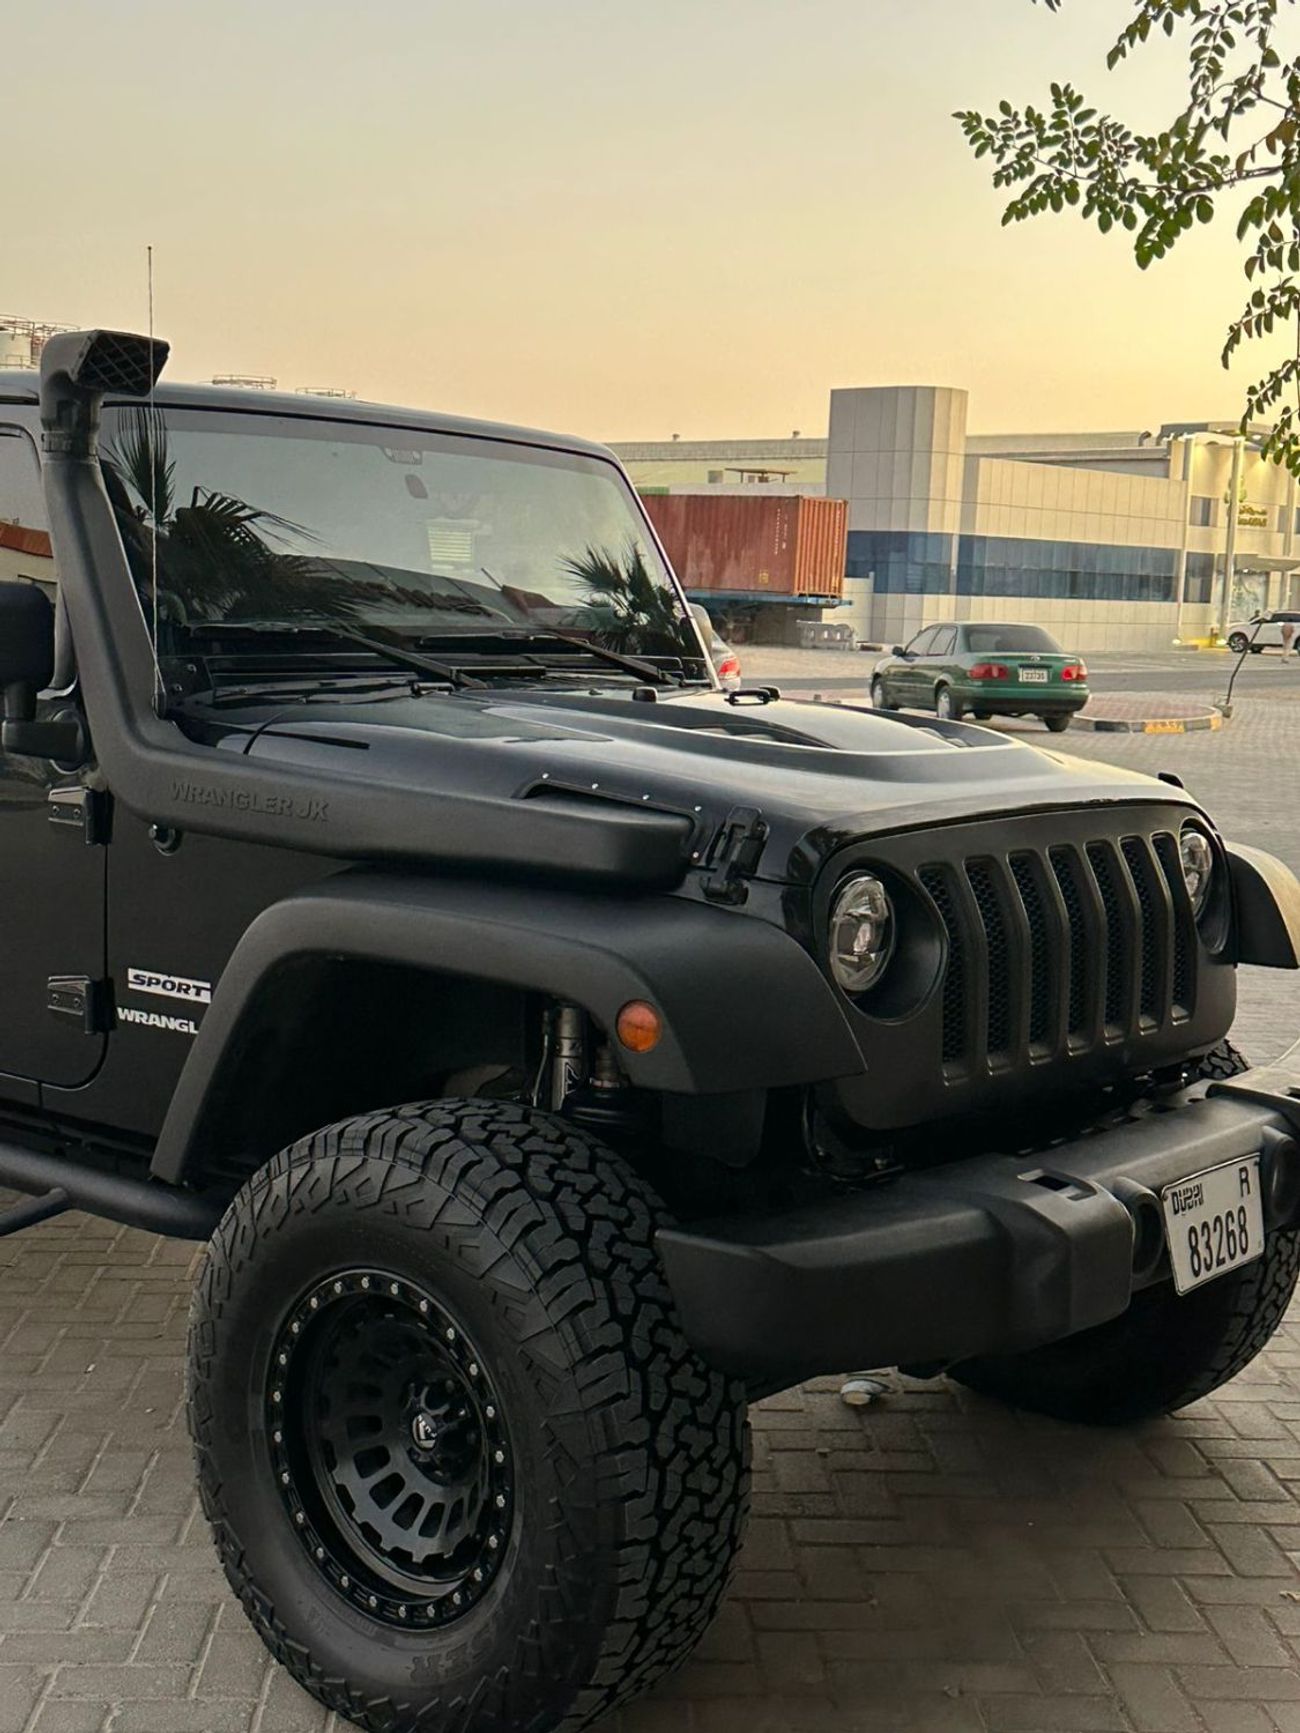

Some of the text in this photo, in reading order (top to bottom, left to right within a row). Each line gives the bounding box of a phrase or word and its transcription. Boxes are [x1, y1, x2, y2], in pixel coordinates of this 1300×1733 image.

[173, 782, 329, 821] WRANGLER JK
[129, 974, 210, 996] SPORT
[1239, 1166, 1251, 1197] R
[1188, 1205, 1249, 1278] 83268
